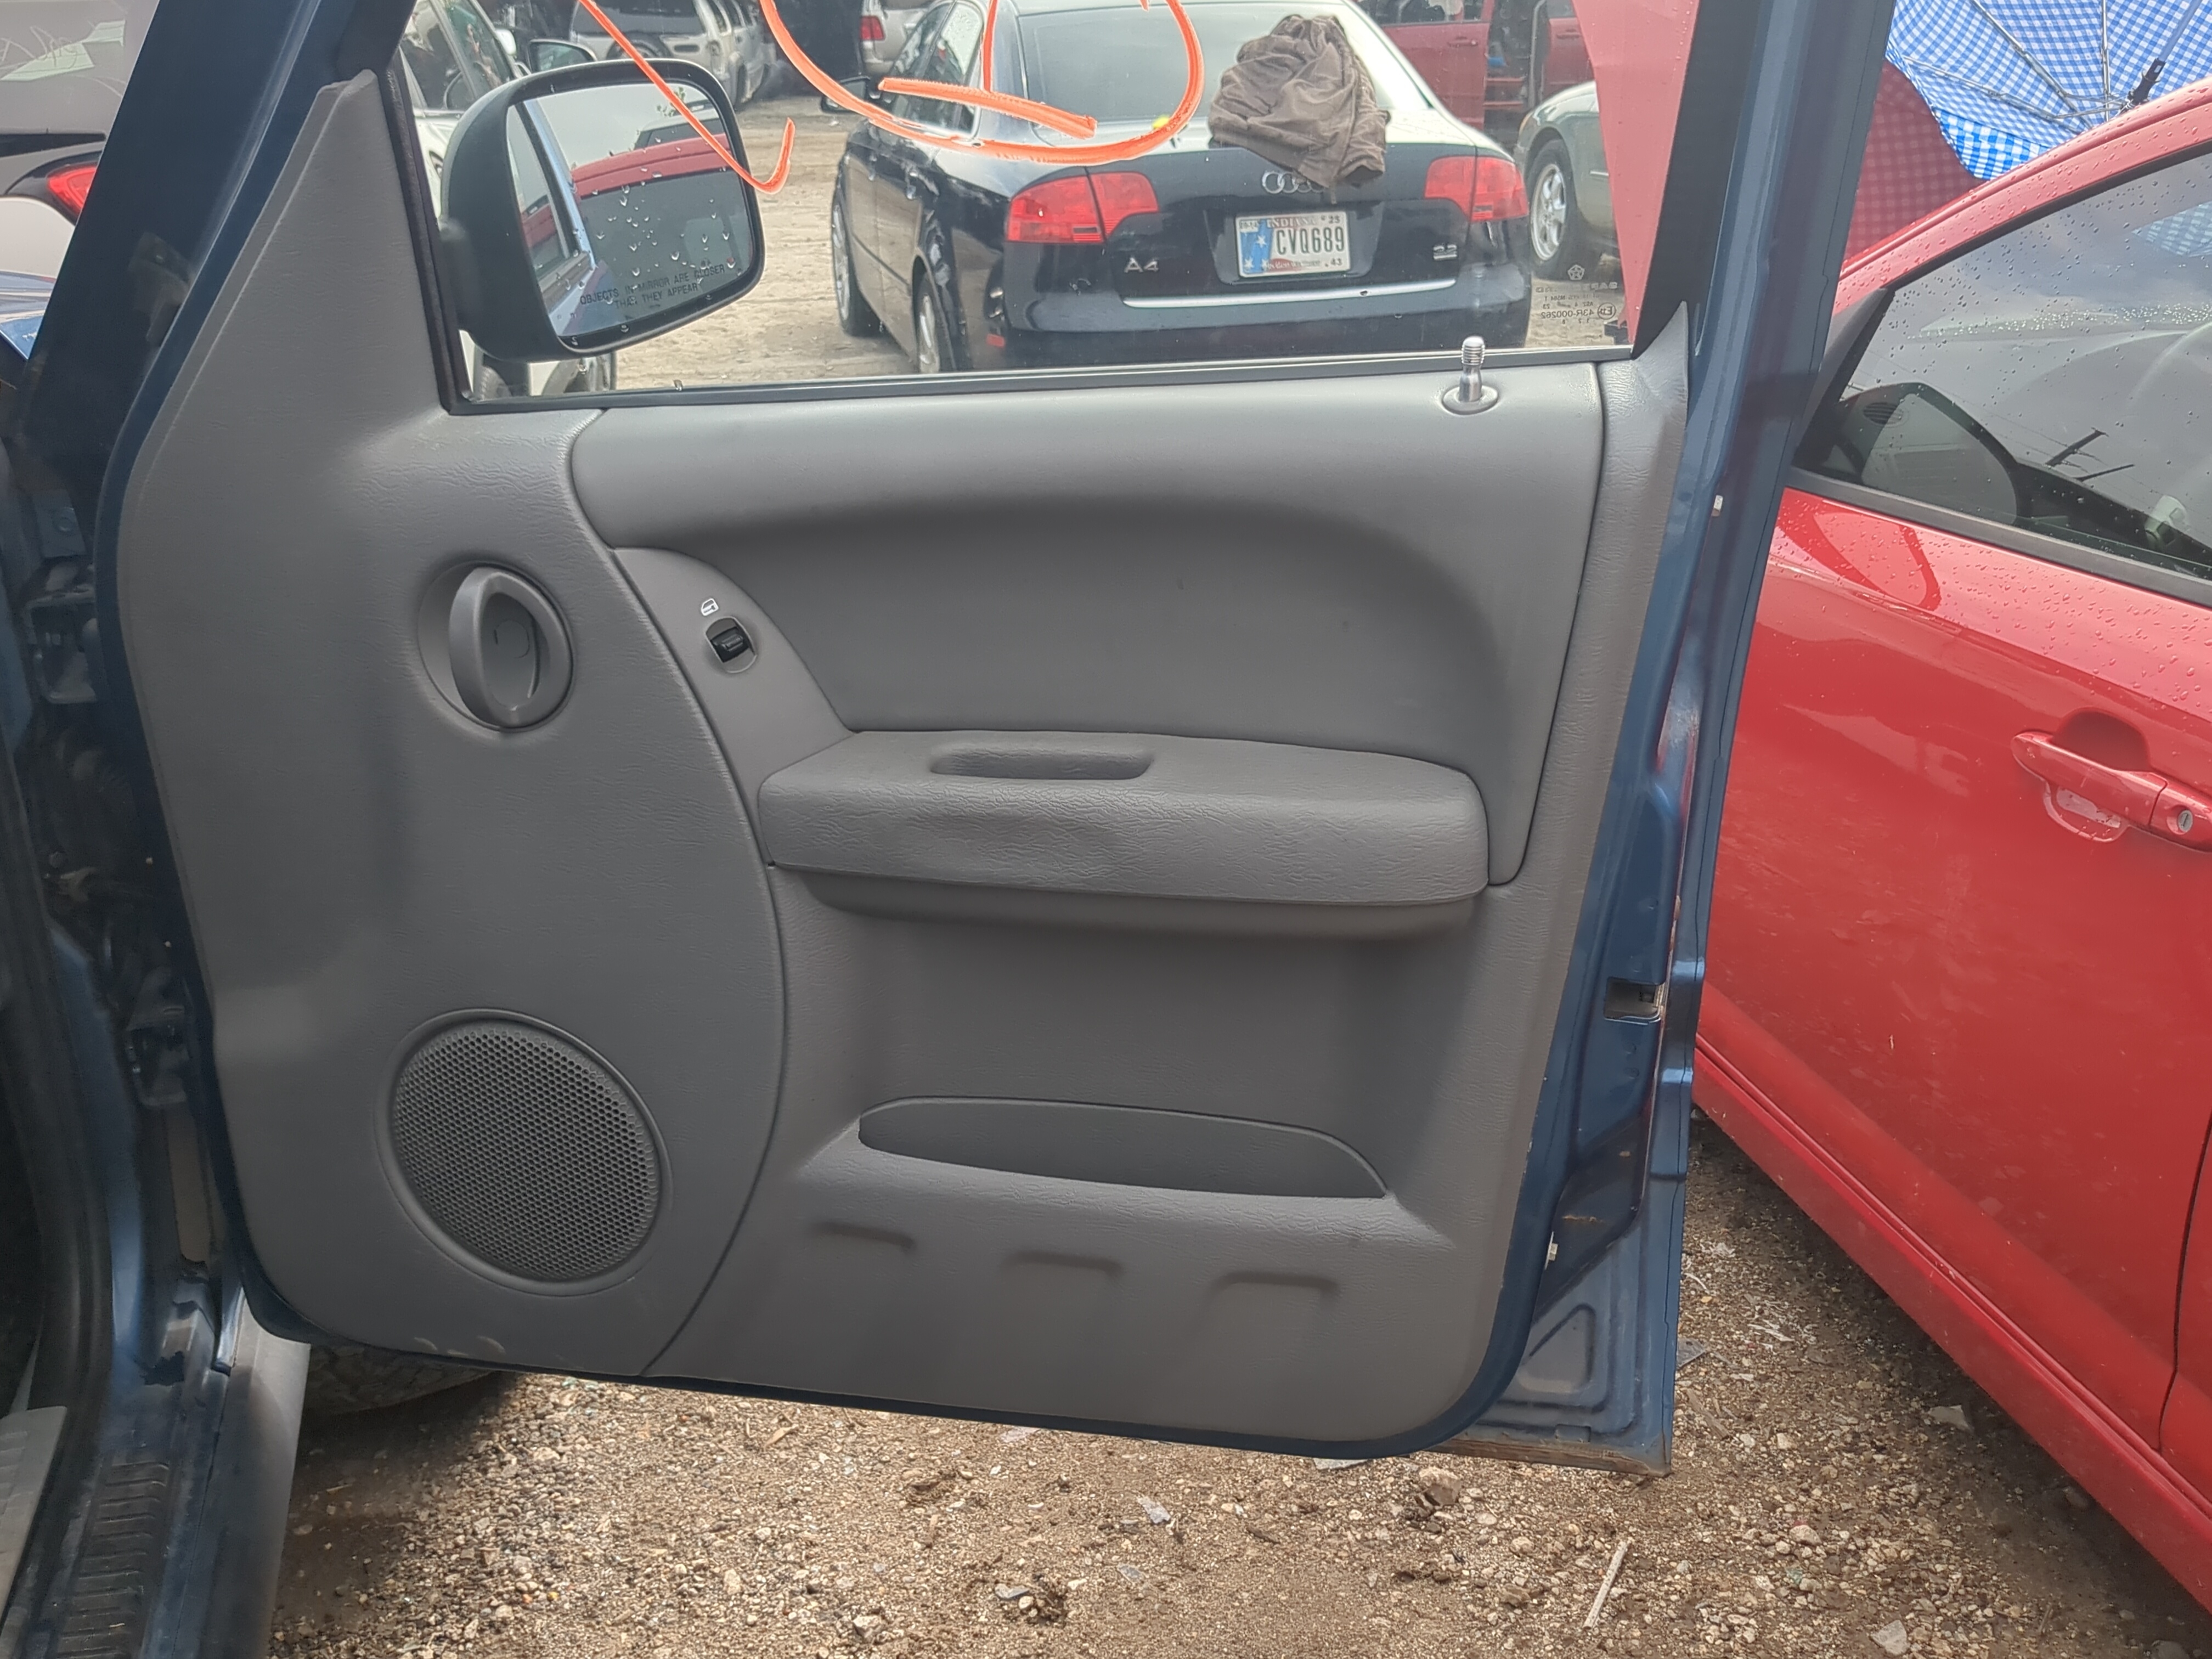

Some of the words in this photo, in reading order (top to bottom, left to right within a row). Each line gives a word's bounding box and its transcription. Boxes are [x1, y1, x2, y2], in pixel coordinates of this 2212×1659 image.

[1276, 227, 1345, 255] CVQ689
[1124, 257, 1159, 273] A4
[580, 288, 619, 305] OBJECTS
[625, 285, 635, 295] IN
[636, 277, 670, 292] MIRROR
[674, 272, 690, 284] ARE
[693, 264, 725, 279] CLOSER
[642, 290, 662, 303] THEY
[668, 283, 698, 297] APPEAR
